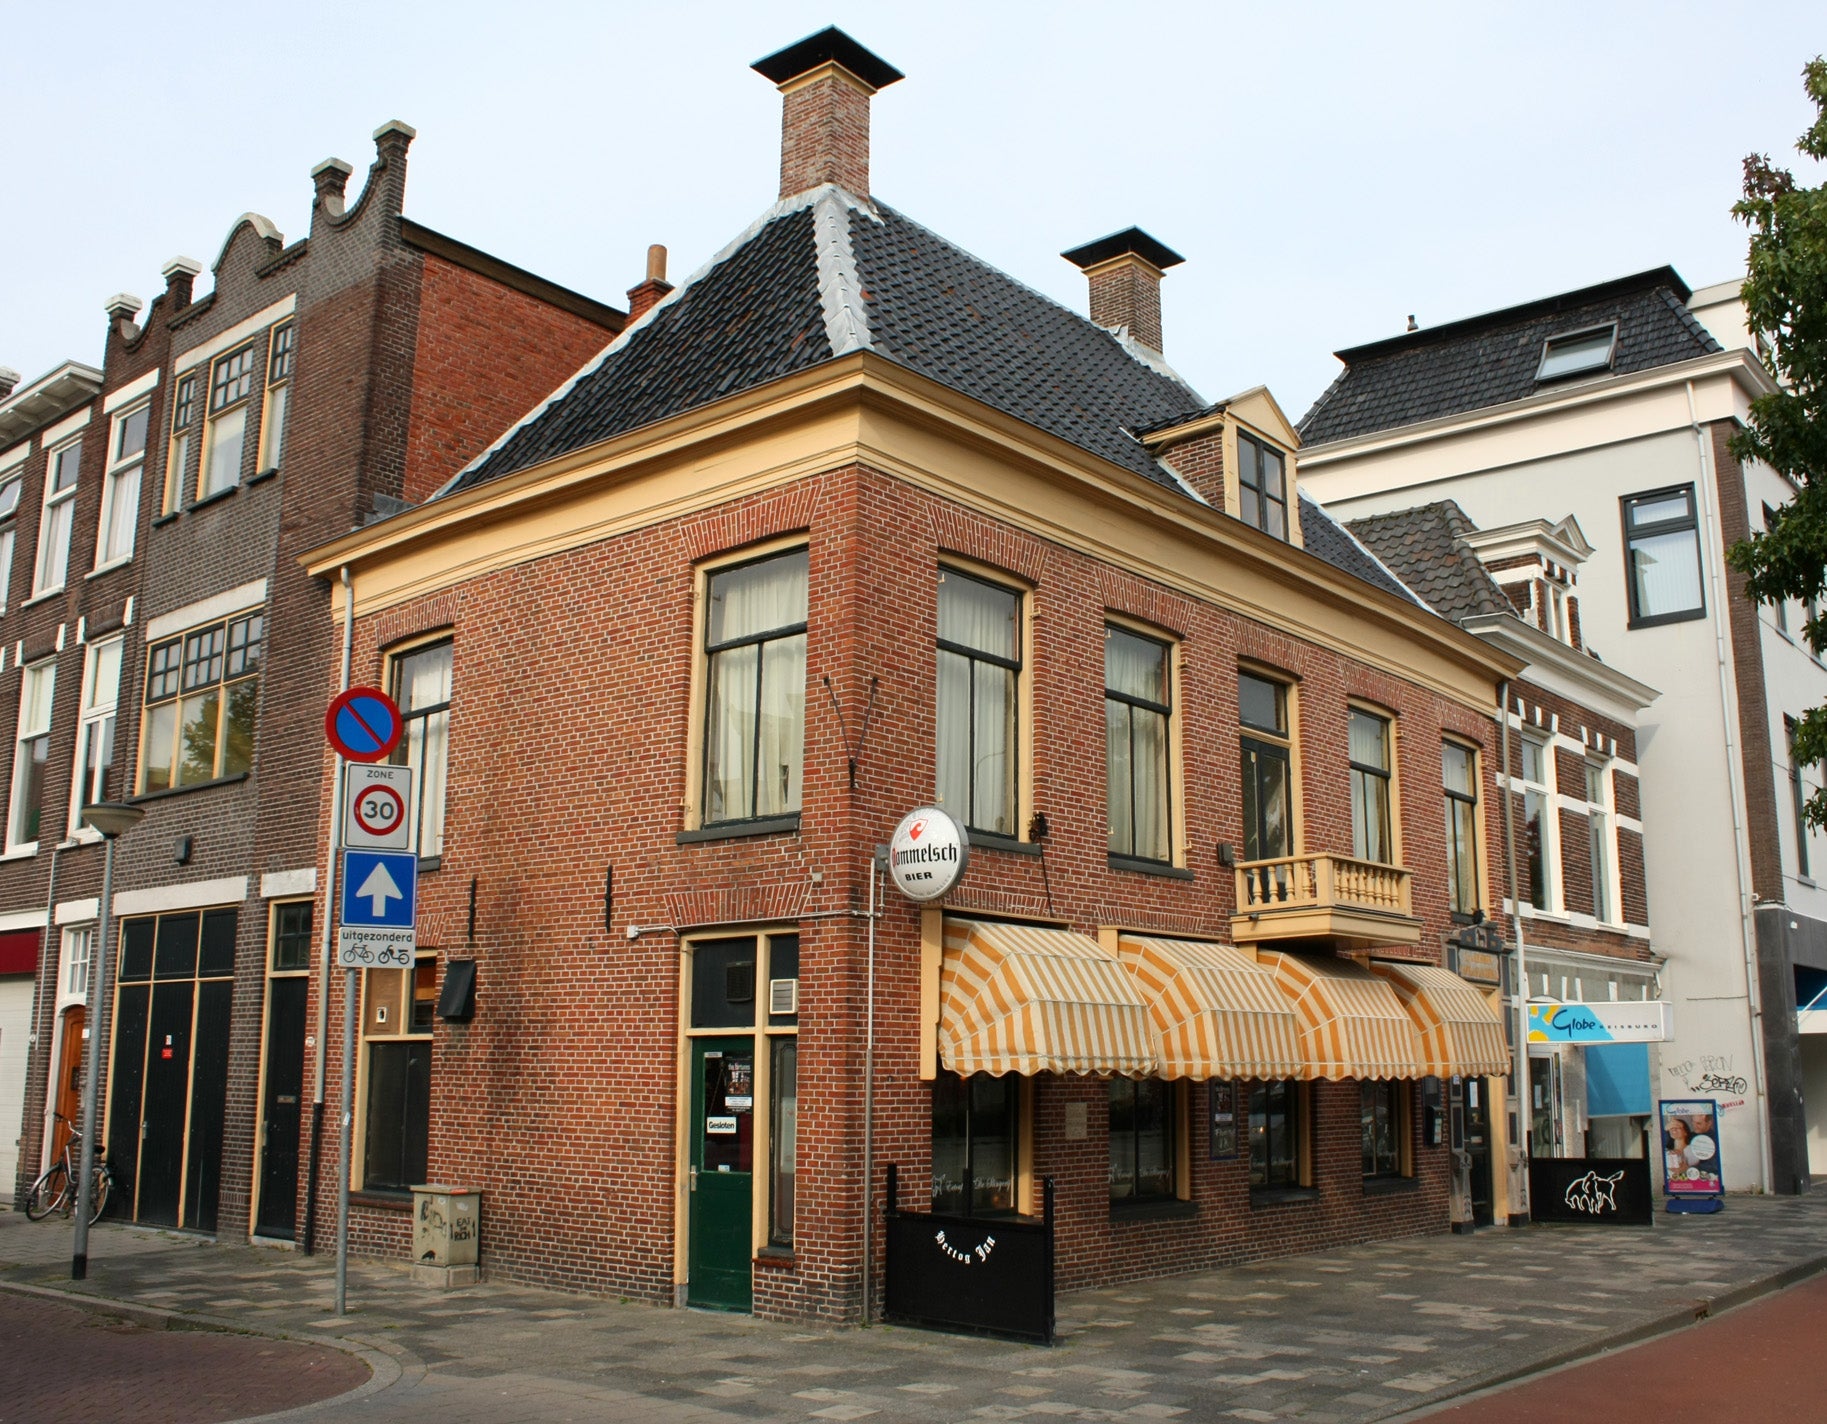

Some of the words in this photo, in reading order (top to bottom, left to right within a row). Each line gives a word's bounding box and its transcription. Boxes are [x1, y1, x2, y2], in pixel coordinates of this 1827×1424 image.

[366, 769, 394, 780] ZONE
[363, 800, 395, 821] 30
[891, 842, 957, 869] Dommelsch
[904, 871, 933, 882] BIER
[342, 930, 413, 944] uitgezonderd
[1552, 1008, 1596, 1039] Globe
[708, 1121, 735, 1130] Gesloten
[934, 1230, 971, 1264] Hertog
[975, 1235, 996, 1263] Jan
